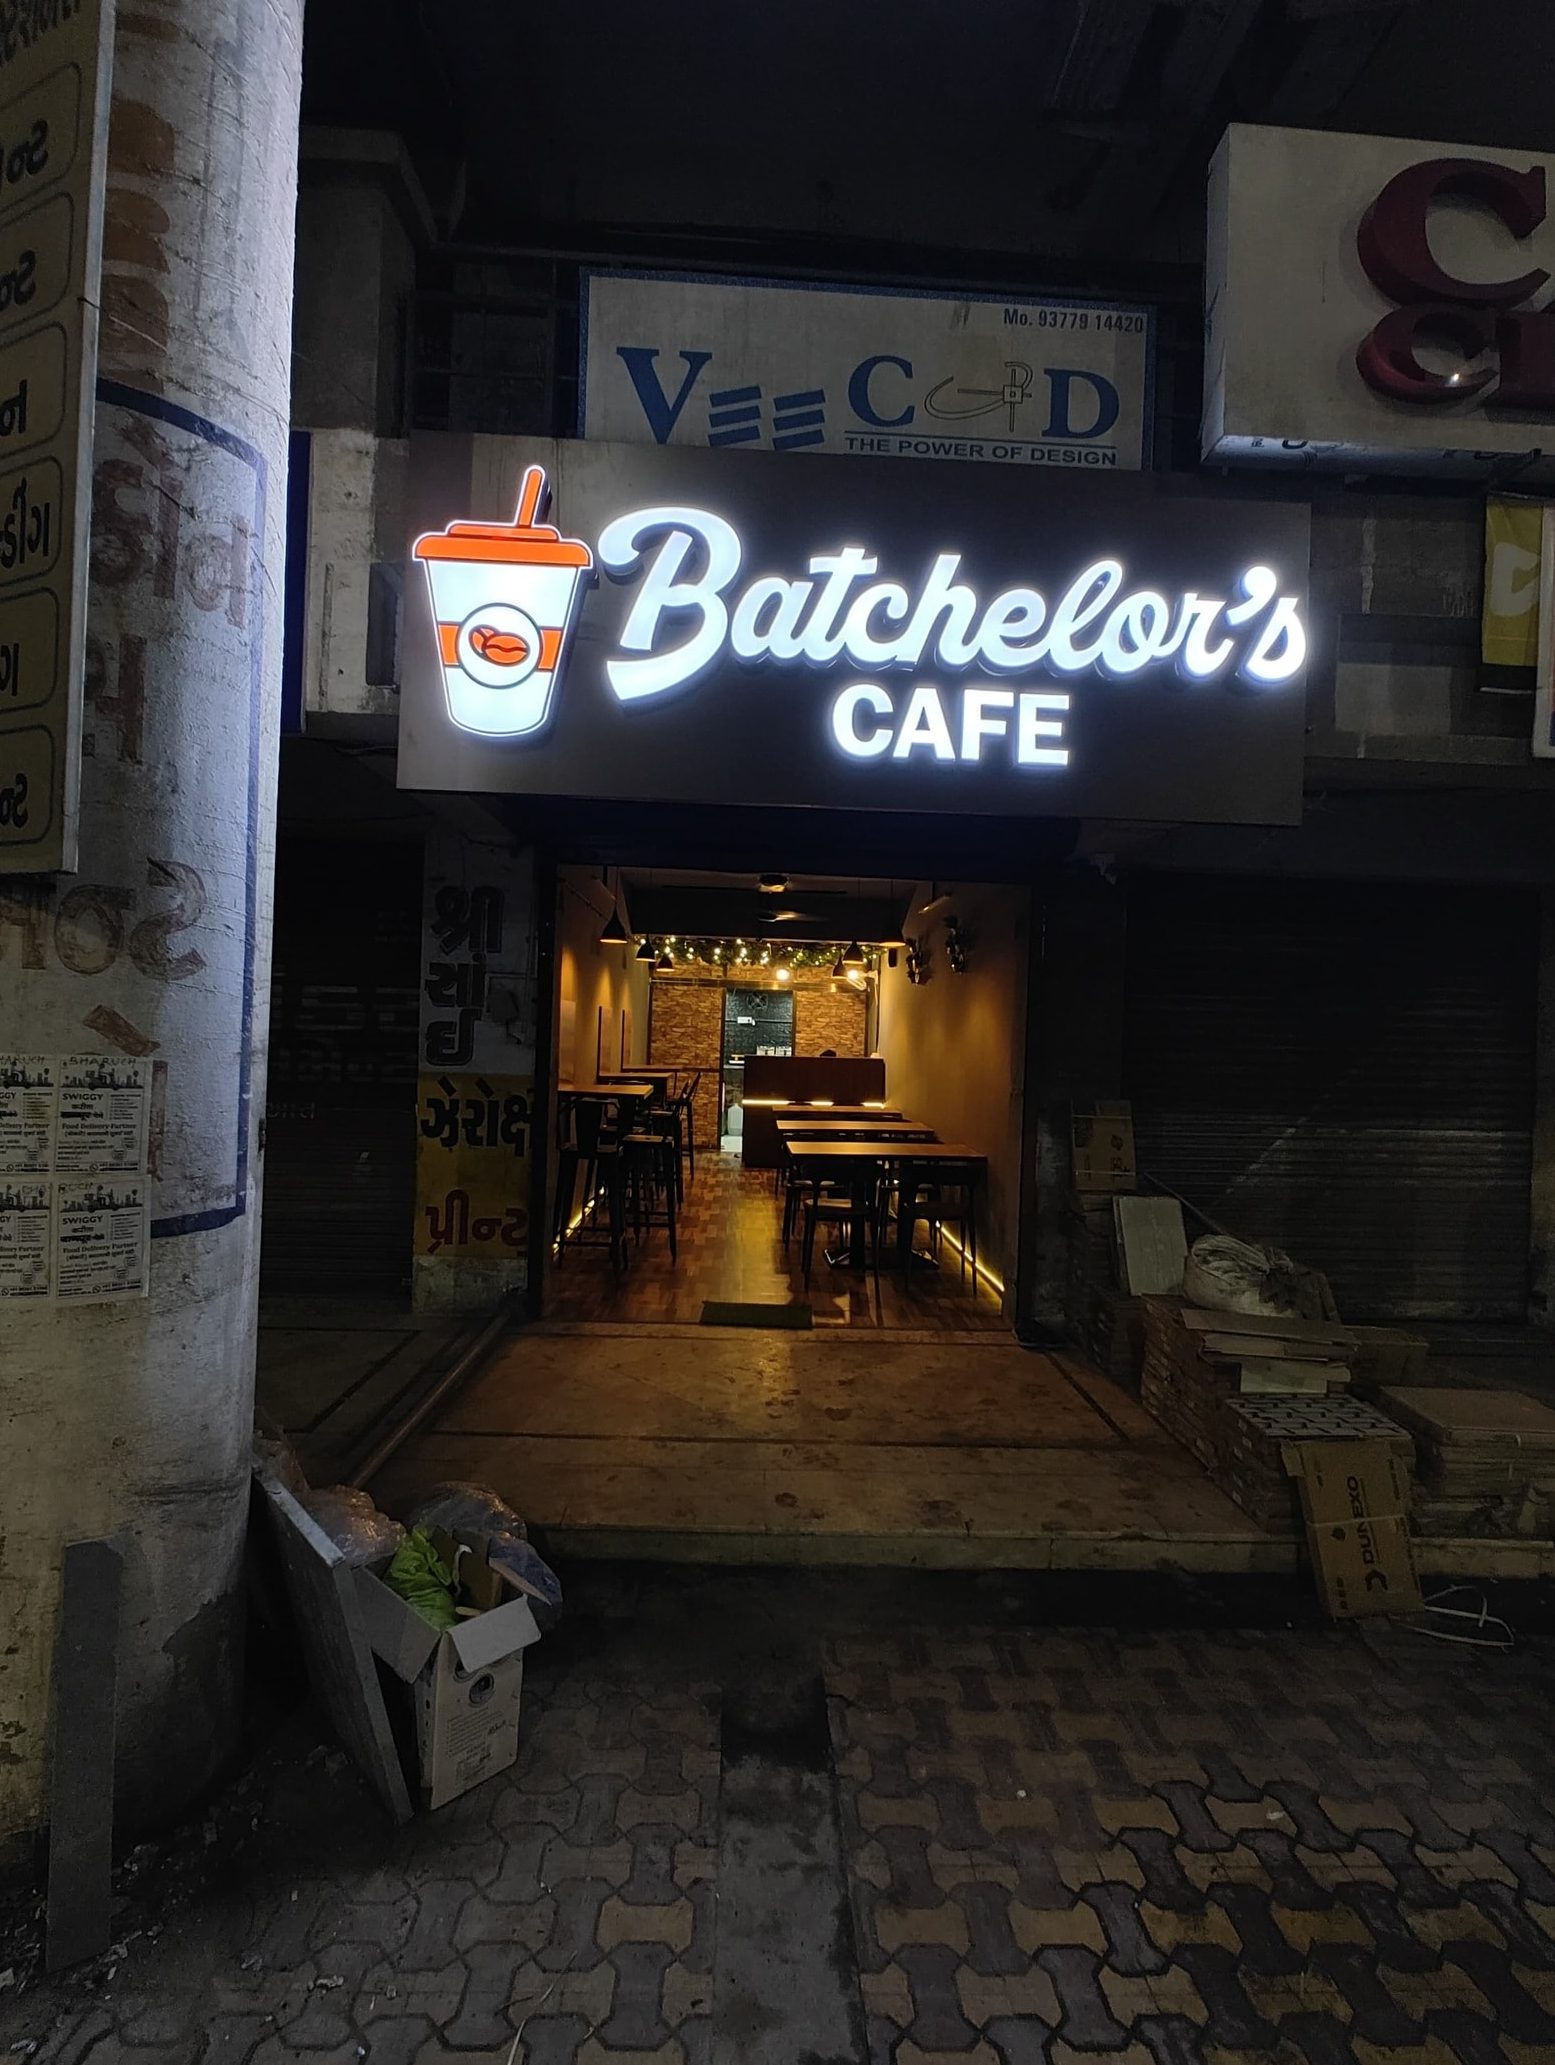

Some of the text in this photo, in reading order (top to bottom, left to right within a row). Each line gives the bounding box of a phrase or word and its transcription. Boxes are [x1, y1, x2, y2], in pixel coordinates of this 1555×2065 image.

[1004, 308, 1144, 333] Mo. 93779 14420
[845, 437, 1116, 466] THE POWER OF DESIGN
[598, 506, 1307, 701] Batchelor's
[832, 683, 1070, 767] CAFE
[62, 1093, 103, 1101] SWIGGY
[62, 1215, 103, 1225] SWIGGY
